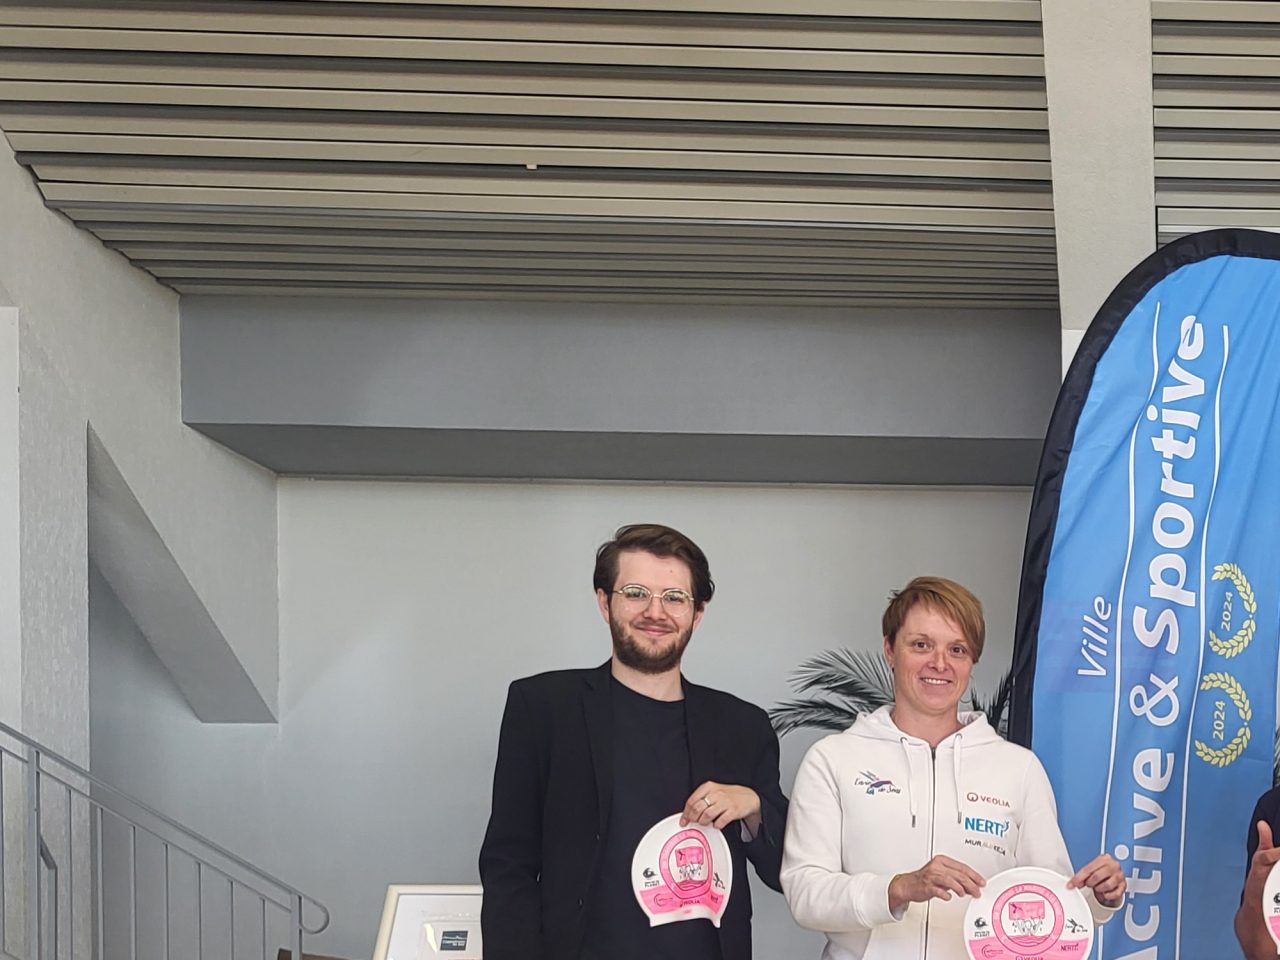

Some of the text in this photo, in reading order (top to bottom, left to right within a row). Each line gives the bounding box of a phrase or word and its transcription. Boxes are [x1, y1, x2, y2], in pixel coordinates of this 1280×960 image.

[1132, 315, 1205, 656] Sportive
[1221, 591, 1234, 632] 2024
[1077, 596, 1112, 676] Ville
[1129, 673, 1180, 727] &
[1212, 700, 1226, 741] 2024
[980, 795, 1010, 808] VEOLIA
